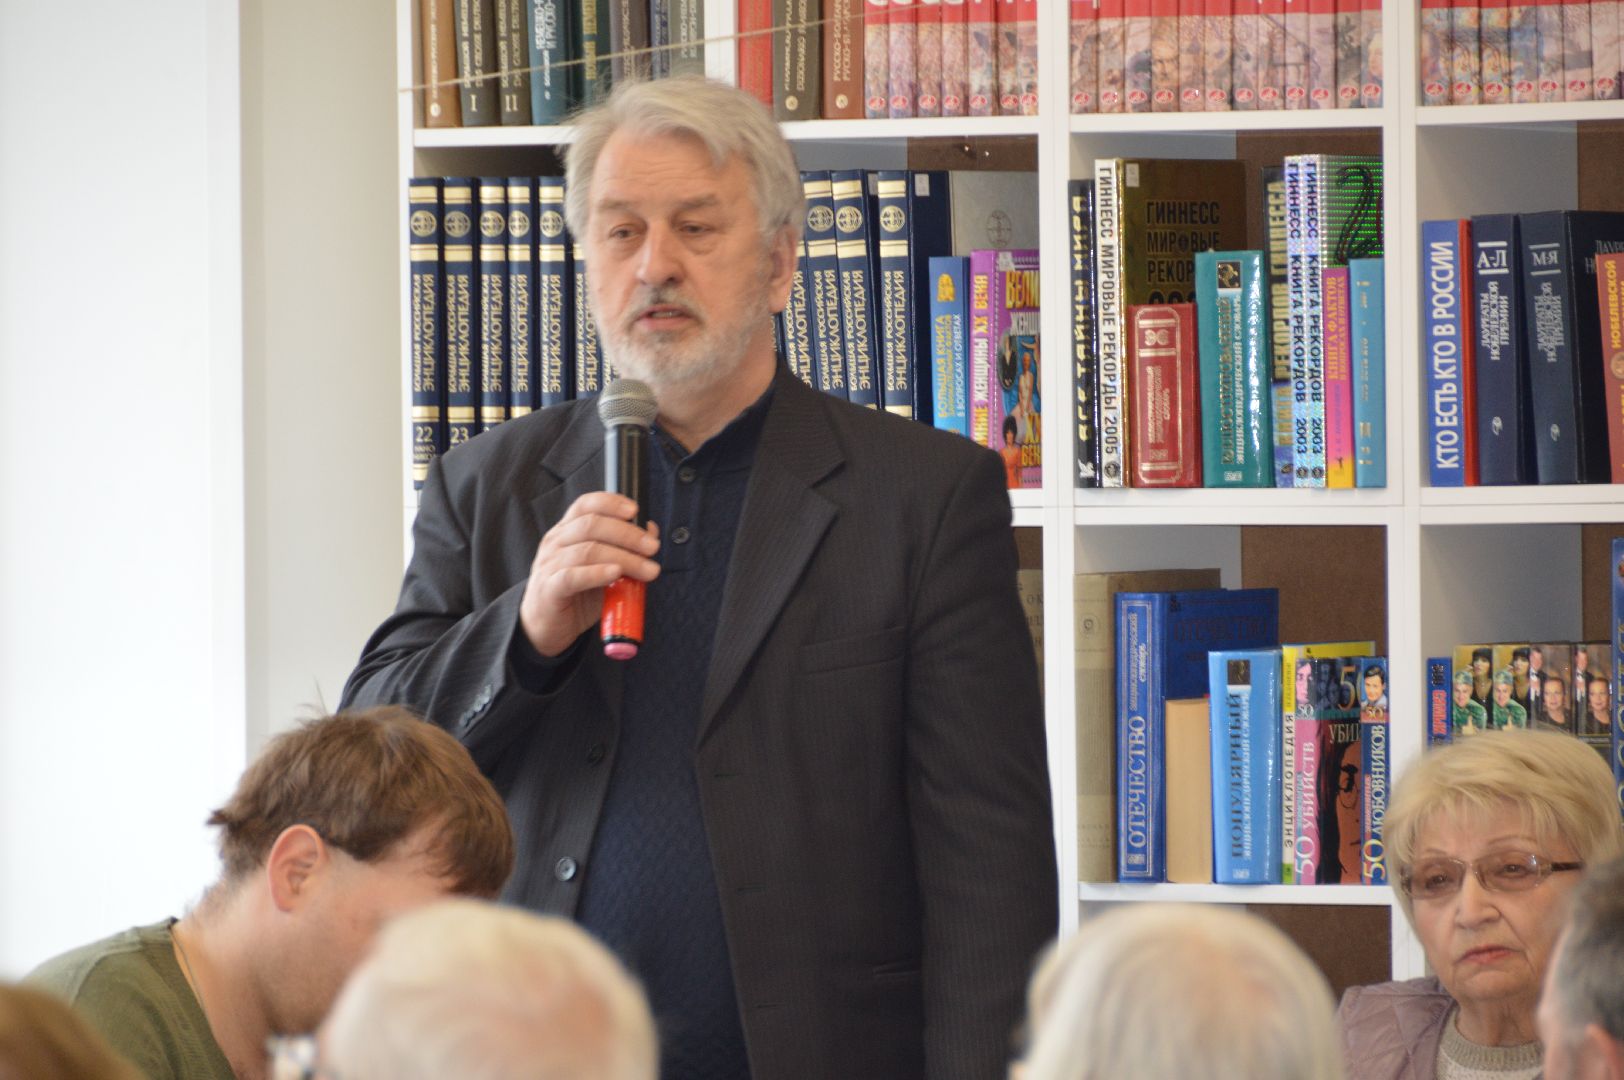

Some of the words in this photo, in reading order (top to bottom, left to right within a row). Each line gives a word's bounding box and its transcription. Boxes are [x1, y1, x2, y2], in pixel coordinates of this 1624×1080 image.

[1072, 196, 1088, 271] МИРА
[1099, 167, 1113, 239] ГИННЕСС
[1146, 201, 1221, 225] ГИННЕСС
[1287, 163, 1301, 239] ГИННЕСС
[1305, 163, 1318, 239] ГИННЕСС
[1101, 244, 1116, 326] МИРОВЫЕ
[1148, 260, 1197, 282] РЕКОР
[1290, 254, 1304, 308] КНИГА
[1307, 254, 1321, 308] КНИГА
[1431, 241, 1455, 319] РОССИИ
[1476, 249, 1508, 268] А-Л
[1532, 250, 1560, 267] М-Я
[421, 274, 435, 392] ЭНЦИКЛОПЕДИЯ
[457, 275, 471, 392] ЭНЦИКЛОПЕДИЯ
[489, 275, 503, 392] ЭНЦИКЛОПЕДИЯ
[517, 274, 529, 392] ЭНЦИКЛОПЕДИЯ
[549, 275, 563, 393] ЭНЦИКЛОПЕДИЯ
[814, 271, 827, 338] РОССИЙСКАЯ
[824, 270, 844, 389] ЭНЦИКЛОПЕДИЯ
[842, 271, 855, 339] РОССИЙСКАЯ
[852, 270, 871, 390] ЭНЦИКЛОПЕДИЯ
[884, 271, 893, 338] РОССИЙСКАЯ
[893, 270, 908, 390] ЭНЦИКЛОПЕДИЯ
[935, 315, 945, 355] КНИГА
[1074, 280, 1091, 378] ТАЙНЫ
[1271, 283, 1292, 379] РЕКОРДОВ
[1432, 323, 1456, 337] В
[1480, 293, 1491, 348] ЛАУРЕАТЫ
[1488, 281, 1501, 361] НОБЕЛЕВСКОЙ
[1499, 295, 1510, 345] ПРЕМИИ
[1604, 260, 1621, 349] НОБЕЛЕВСКОЙ
[818, 341, 831, 391] БОЛЬШАЯ
[847, 342, 858, 391] БОЛЬШАЯ
[886, 342, 895, 391] БОЛЬШАЯ
[936, 357, 948, 418] БОЛЬШАЯ
[1102, 332, 1118, 411] РЕКОРДЫ
[1292, 314, 1308, 403] РЕКОРДОВ
[1309, 314, 1324, 403] РЕКОРДОВ
[1433, 340, 1457, 379] КТО
[416, 426, 434, 443] 22
[451, 427, 469, 444] 23
[1104, 415, 1118, 455] 2005
[1296, 418, 1308, 455] 2003
[1311, 418, 1324, 455] 2003
[1434, 382, 1458, 427] ЕСТЬ
[1435, 429, 1459, 468] КТО
[1128, 716, 1147, 849] ОТЕЧЕСТВО
[1226, 693, 1243, 858] ПОПУЛЯРНЫЙ
[1284, 713, 1295, 849] ЭНЦИКЛОПЕДИЯ
[1300, 742, 1315, 830] УБИЙСТВ
[1370, 725, 1387, 836] ЛЮБОВНИКОВ
[1295, 835, 1316, 877] 50
[1363, 839, 1386, 881] 50
